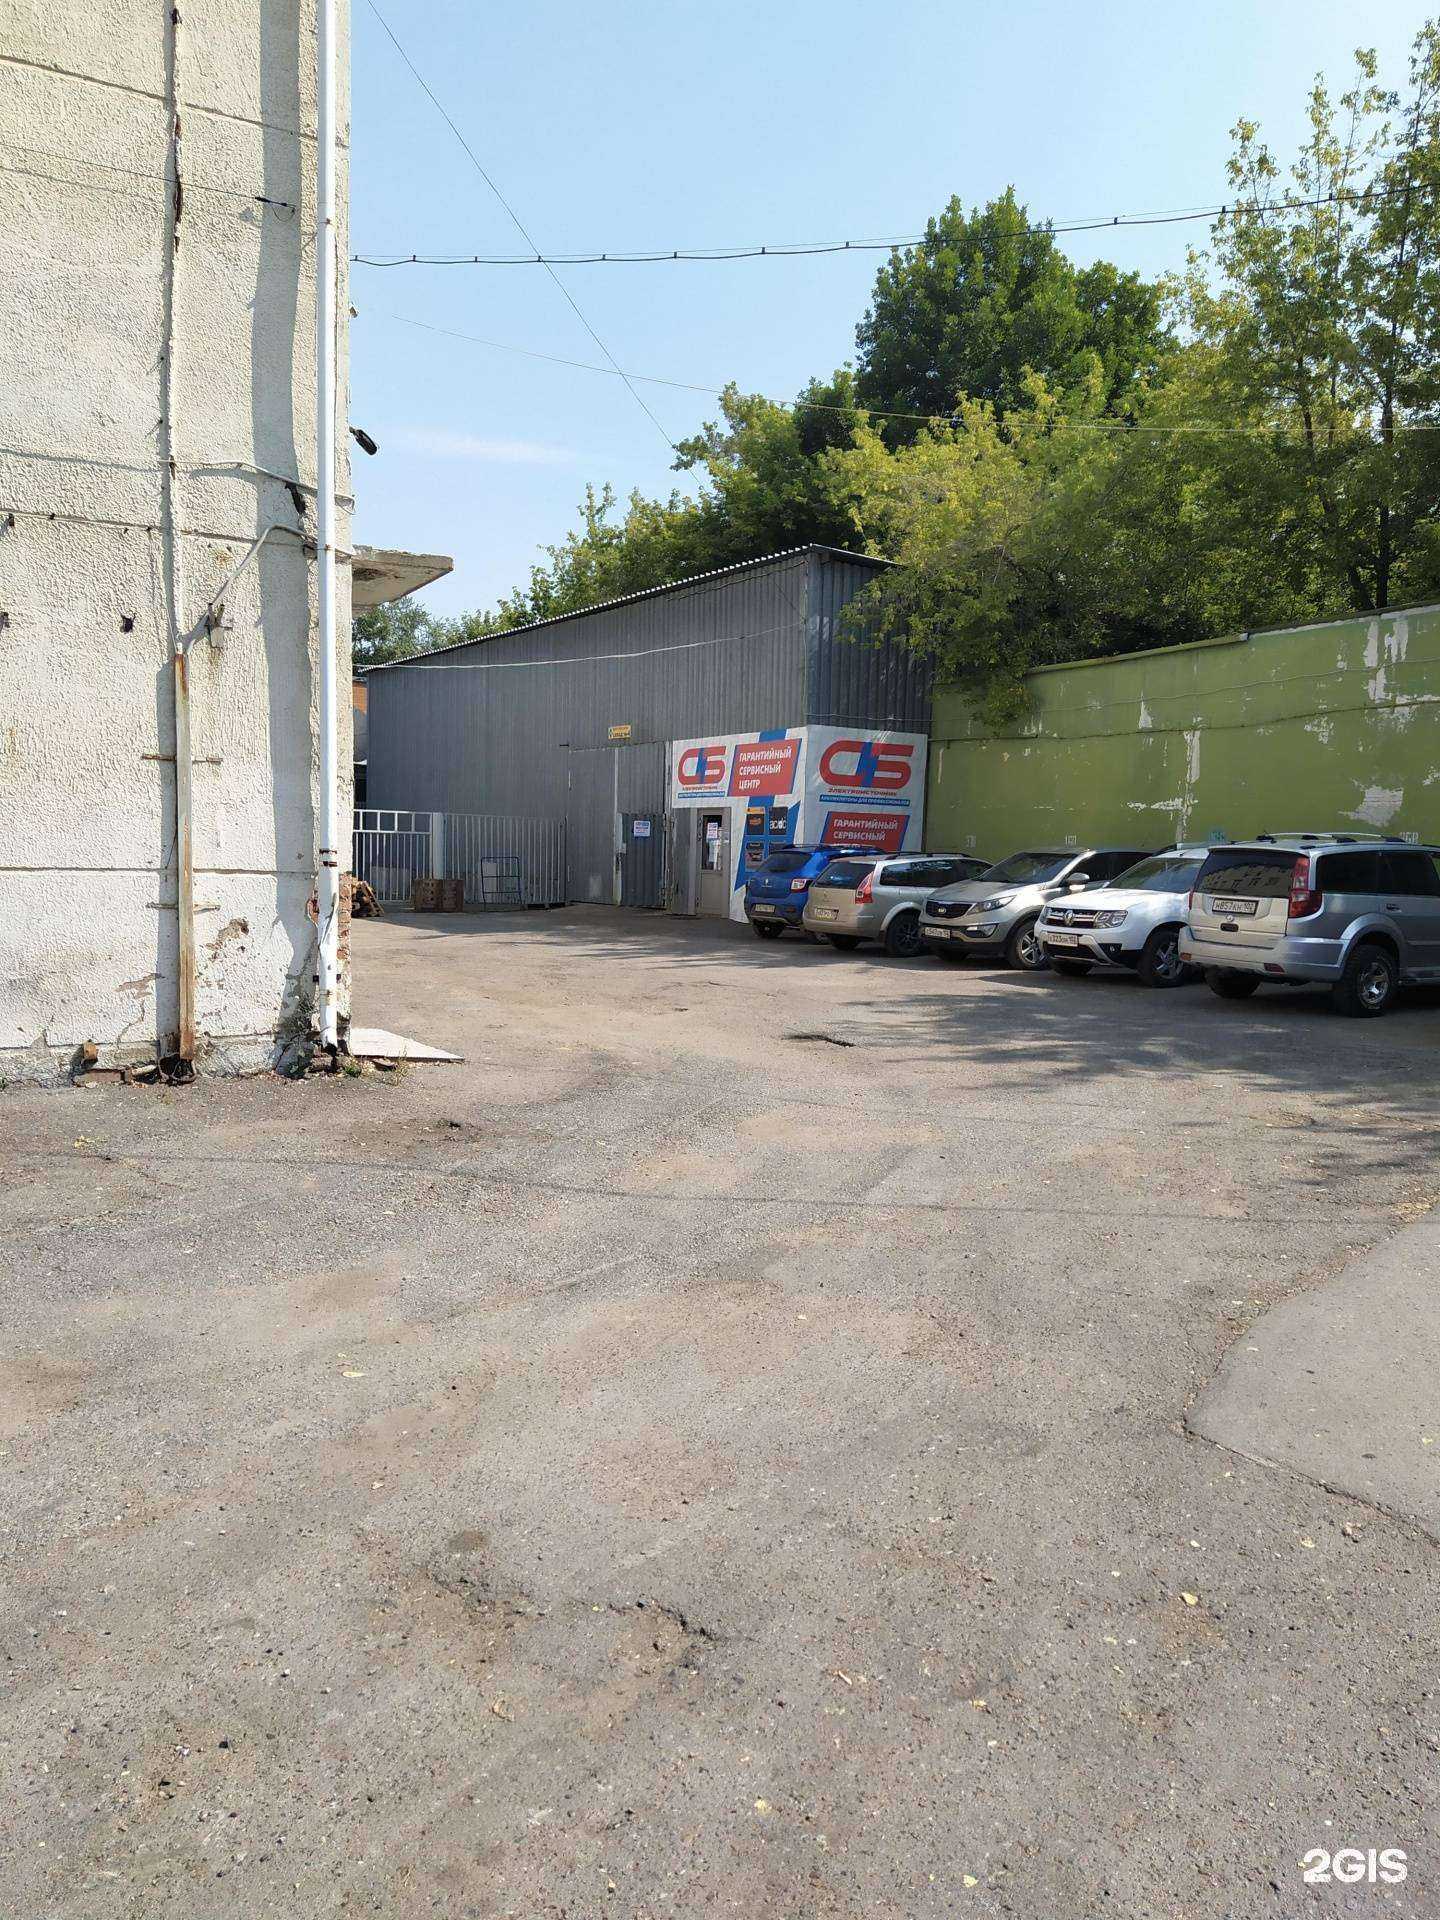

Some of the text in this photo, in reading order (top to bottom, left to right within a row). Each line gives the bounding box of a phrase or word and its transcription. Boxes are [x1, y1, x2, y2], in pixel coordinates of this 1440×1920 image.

[739, 745, 793, 762] ГАРАНТИЙНЫЙ
[739, 761, 782, 776] СЕРВИСНЫЙ
[738, 779, 761, 790] ЦЕНТР
[833, 818, 898, 830] ГАРАНТИЙНЫЙ
[833, 830, 886, 841] СЕРВИСНЫЙ
